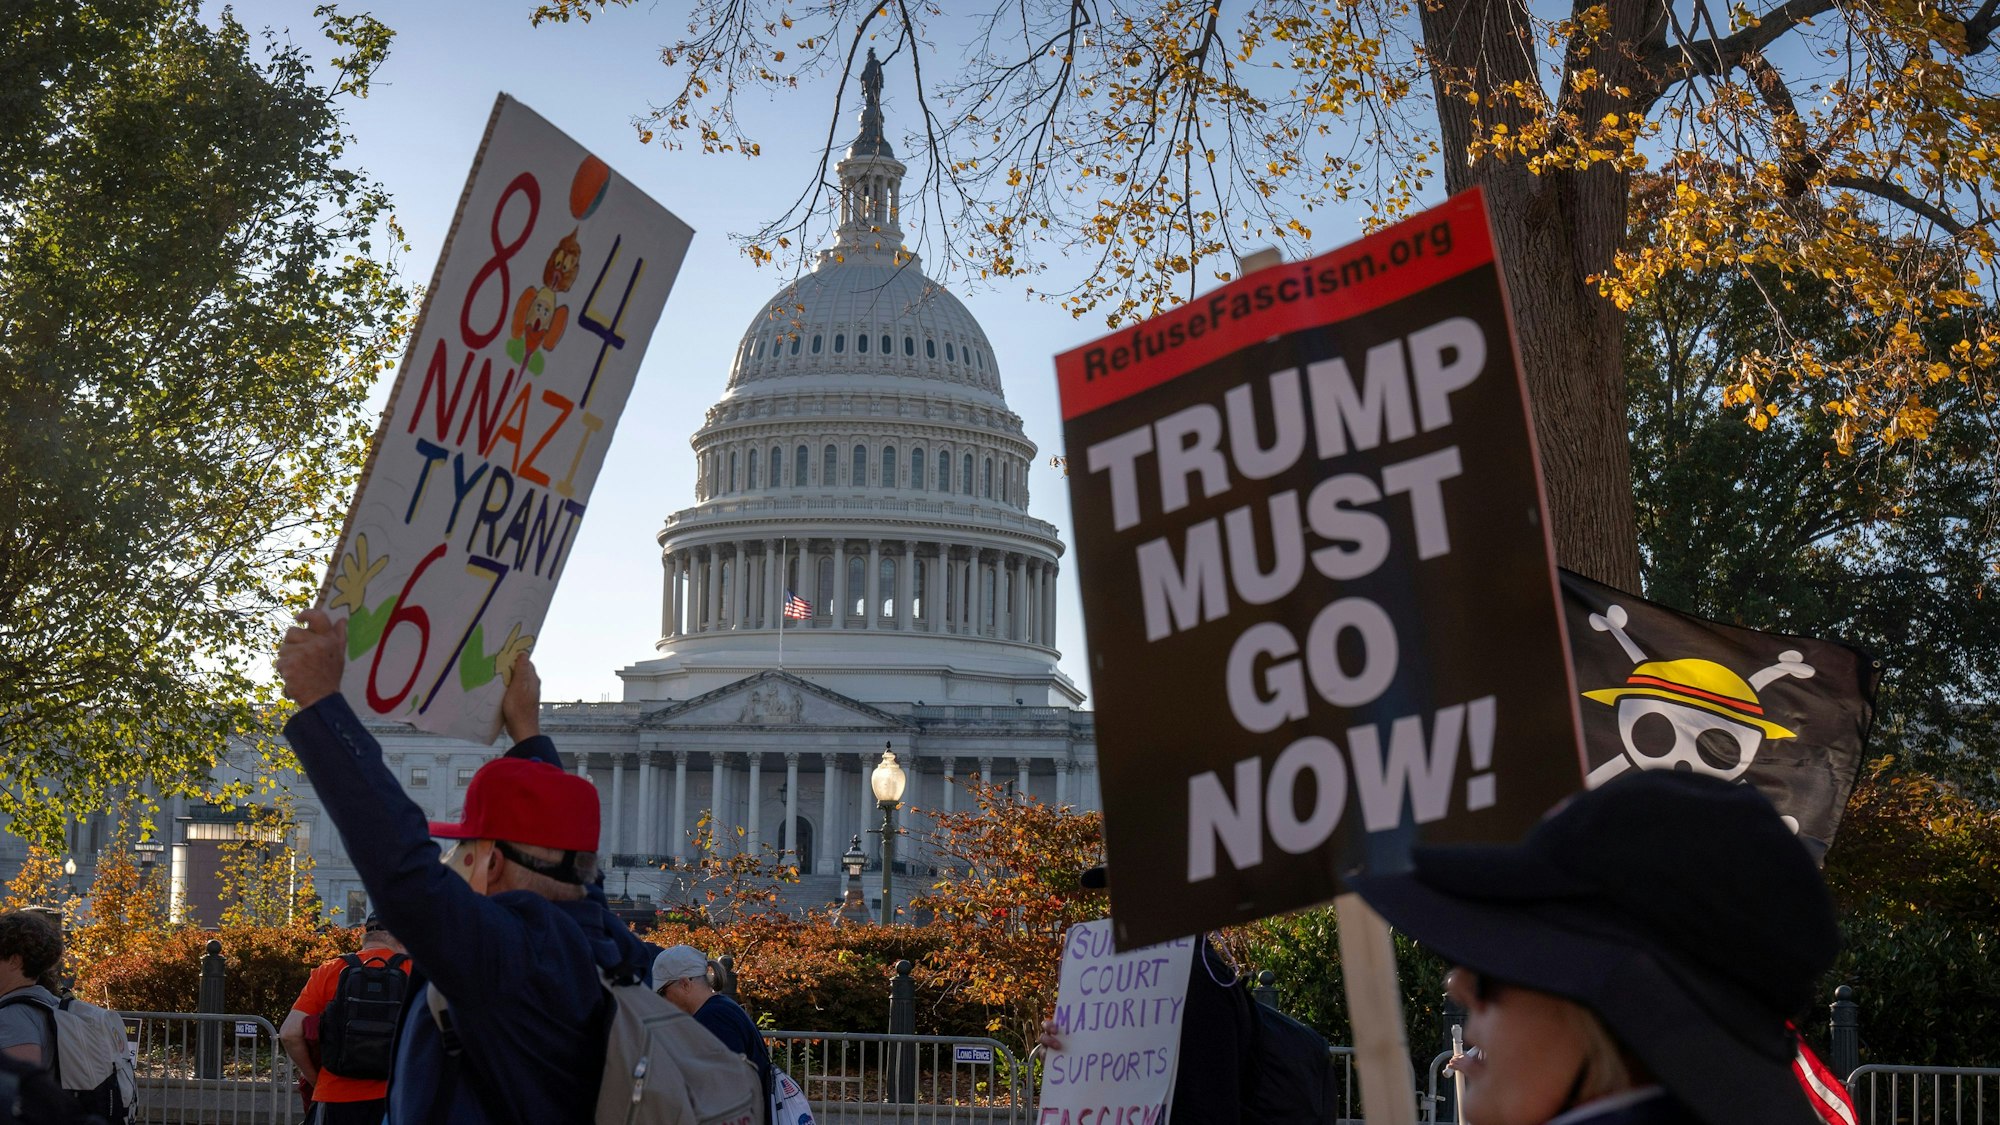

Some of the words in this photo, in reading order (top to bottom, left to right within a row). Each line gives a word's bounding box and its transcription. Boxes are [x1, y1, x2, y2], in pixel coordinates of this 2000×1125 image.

[1082, 219, 1454, 384] RefuseFascism.org
[1086, 316, 1488, 532] TRUMP
[403, 437, 586, 581] TYRANT
[1135, 446, 1463, 643] MUST
[1226, 596, 1399, 733] GO
[1187, 694, 1497, 884] NOW!
[1055, 996, 1183, 1036] MAJORITY
[1079, 958, 1169, 996] COURT
[956, 1049, 972, 1060] LONG
[972, 1049, 990, 1060] FENCE
[1049, 1046, 1168, 1085] SUPPORTS
